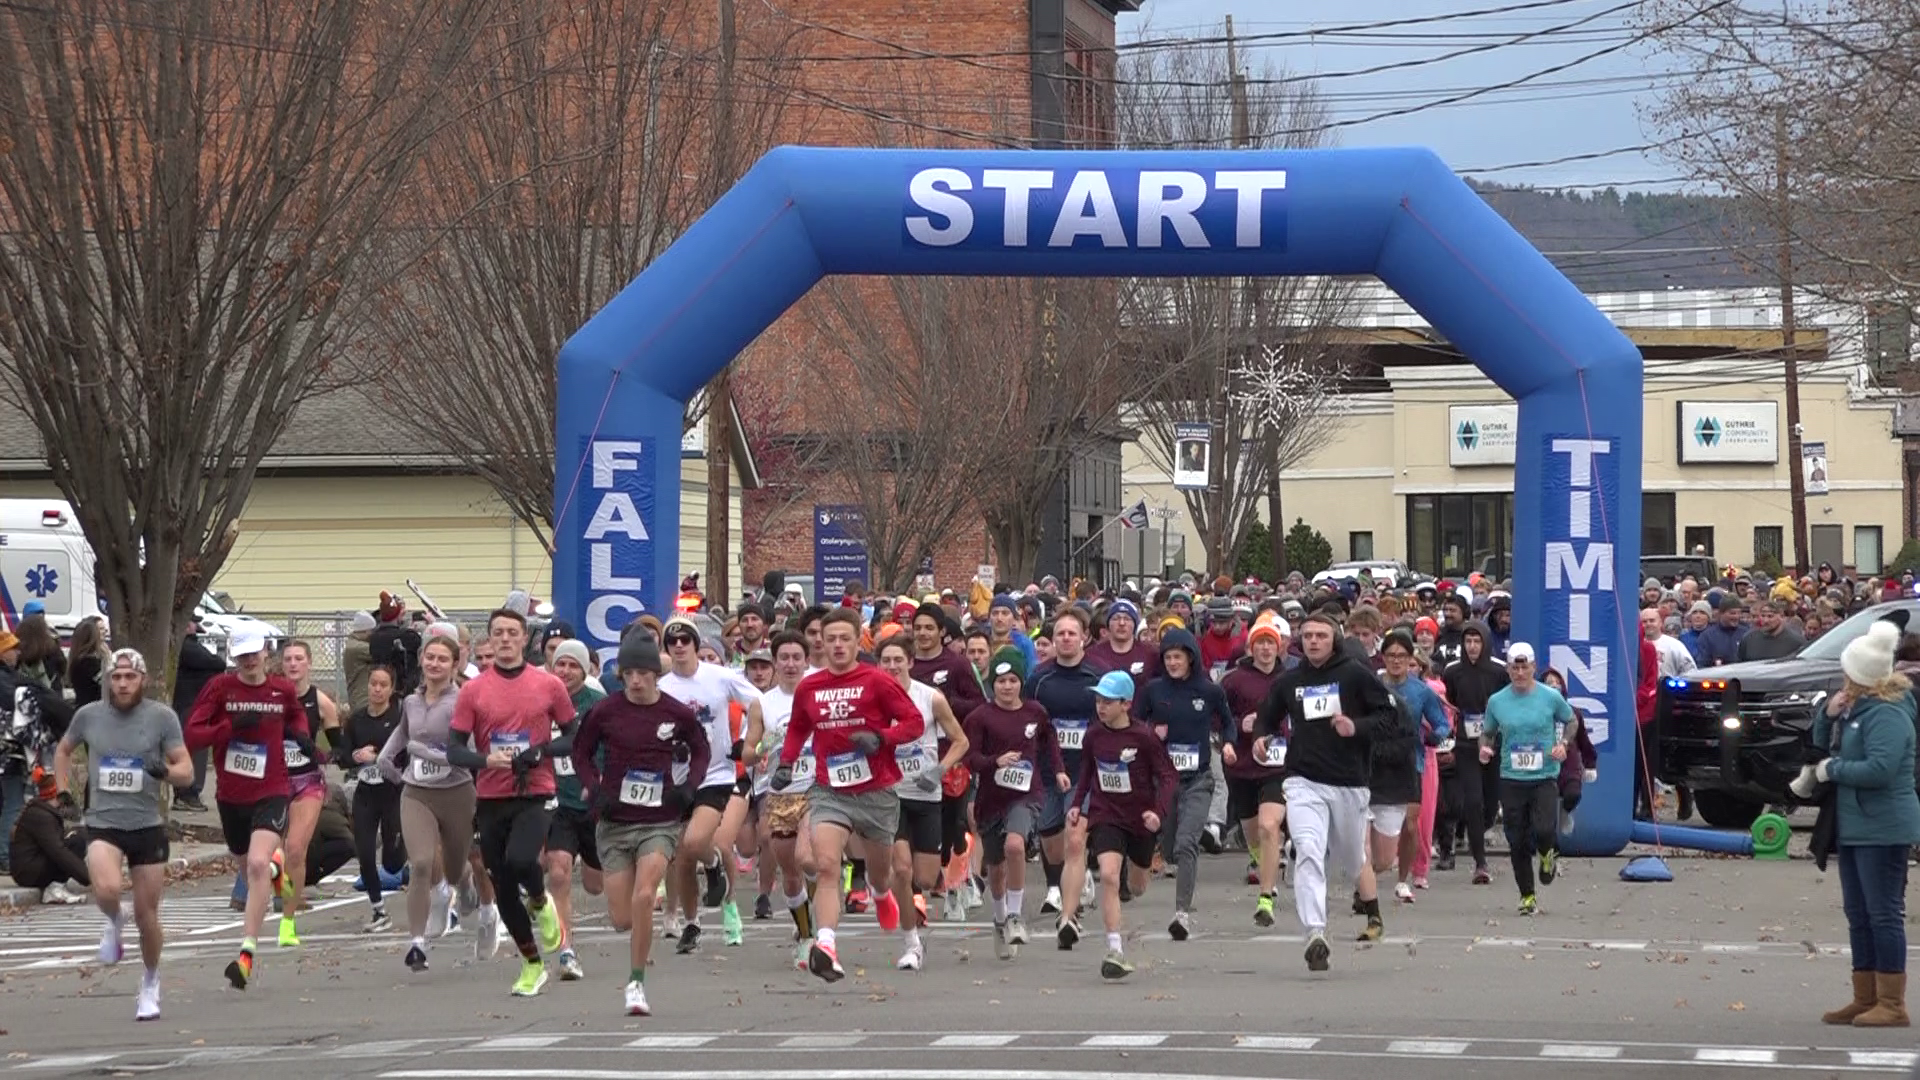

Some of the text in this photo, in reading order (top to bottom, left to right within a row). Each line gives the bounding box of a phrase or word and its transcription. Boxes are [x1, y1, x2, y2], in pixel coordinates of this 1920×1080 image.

[905, 168, 1287, 248] START
[1482, 432, 1515, 440] COMMUNIT
[1545, 439, 1614, 745] TIMING
[814, 686, 864, 703] WAVERLY
[828, 701, 849, 719] XC
[1314, 698, 1328, 712] 47
[234, 754, 257, 771] 609
[1517, 754, 1536, 766] 307
[108, 771, 133, 787] 899
[836, 764, 861, 783] 679
[1002, 767, 1024, 785] 605
[1102, 773, 1122, 788] 608
[630, 784, 654, 801] 571
